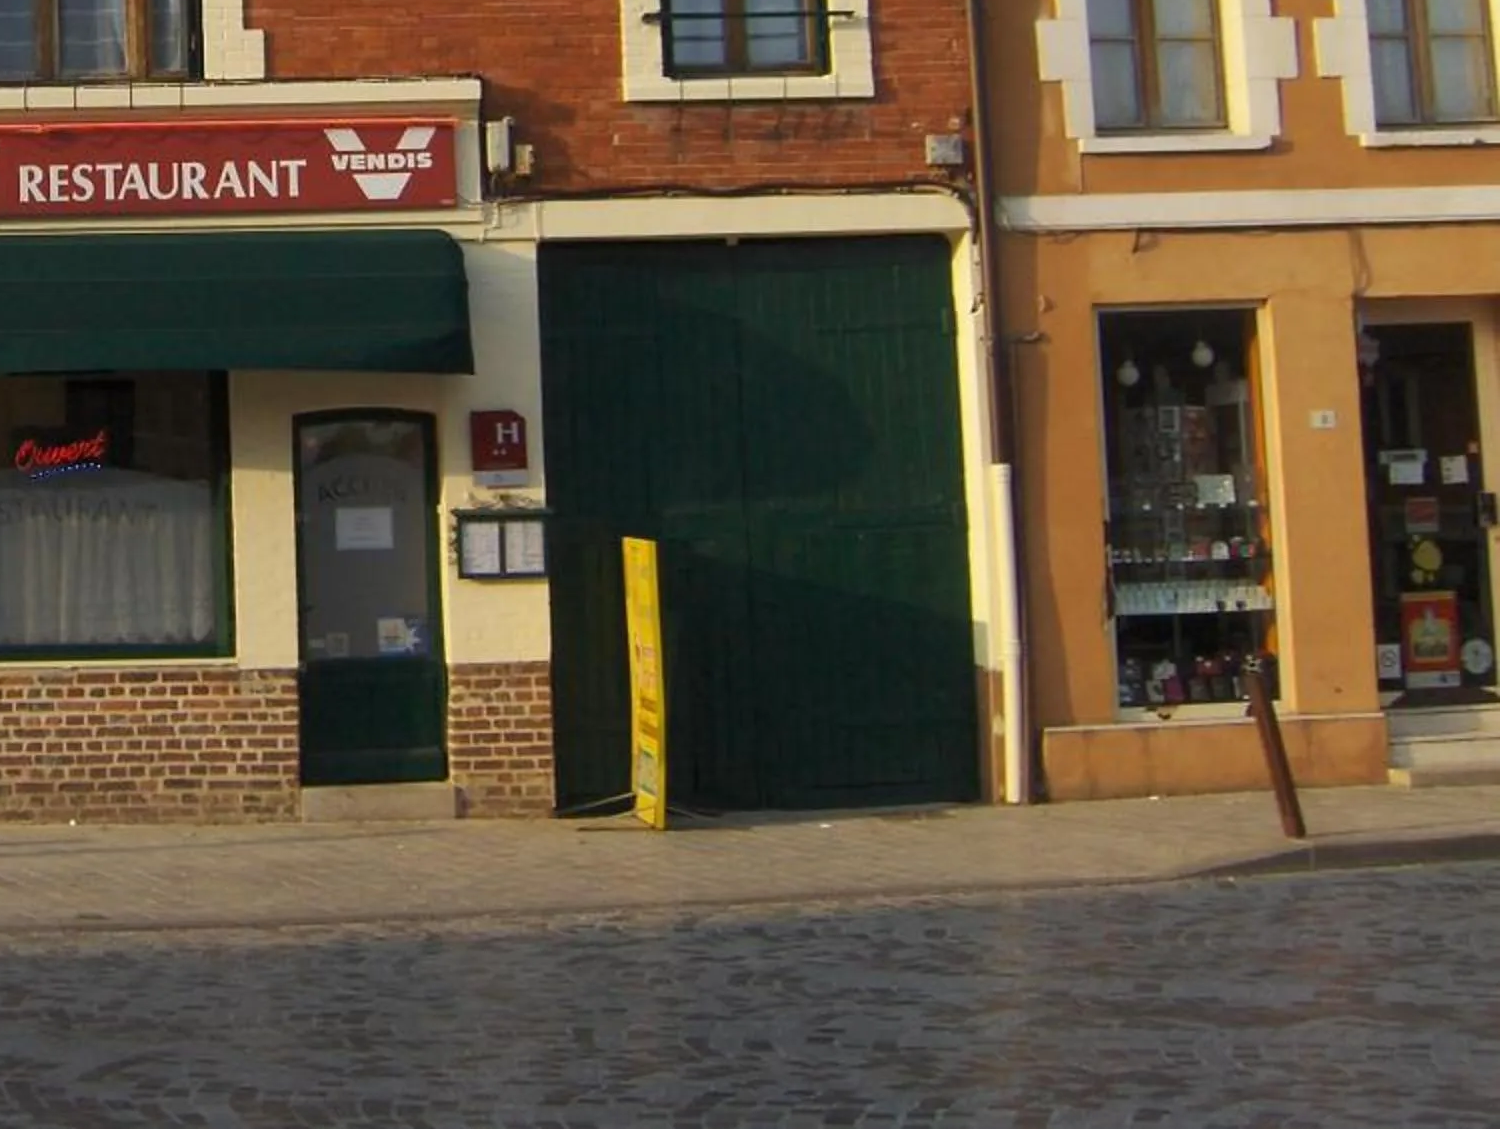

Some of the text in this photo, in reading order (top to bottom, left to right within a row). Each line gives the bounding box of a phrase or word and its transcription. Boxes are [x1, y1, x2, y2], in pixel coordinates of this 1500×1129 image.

[331, 152, 433, 171] VENDIS
[19, 158, 307, 203] RESTAURANT
[495, 421, 520, 445] H
